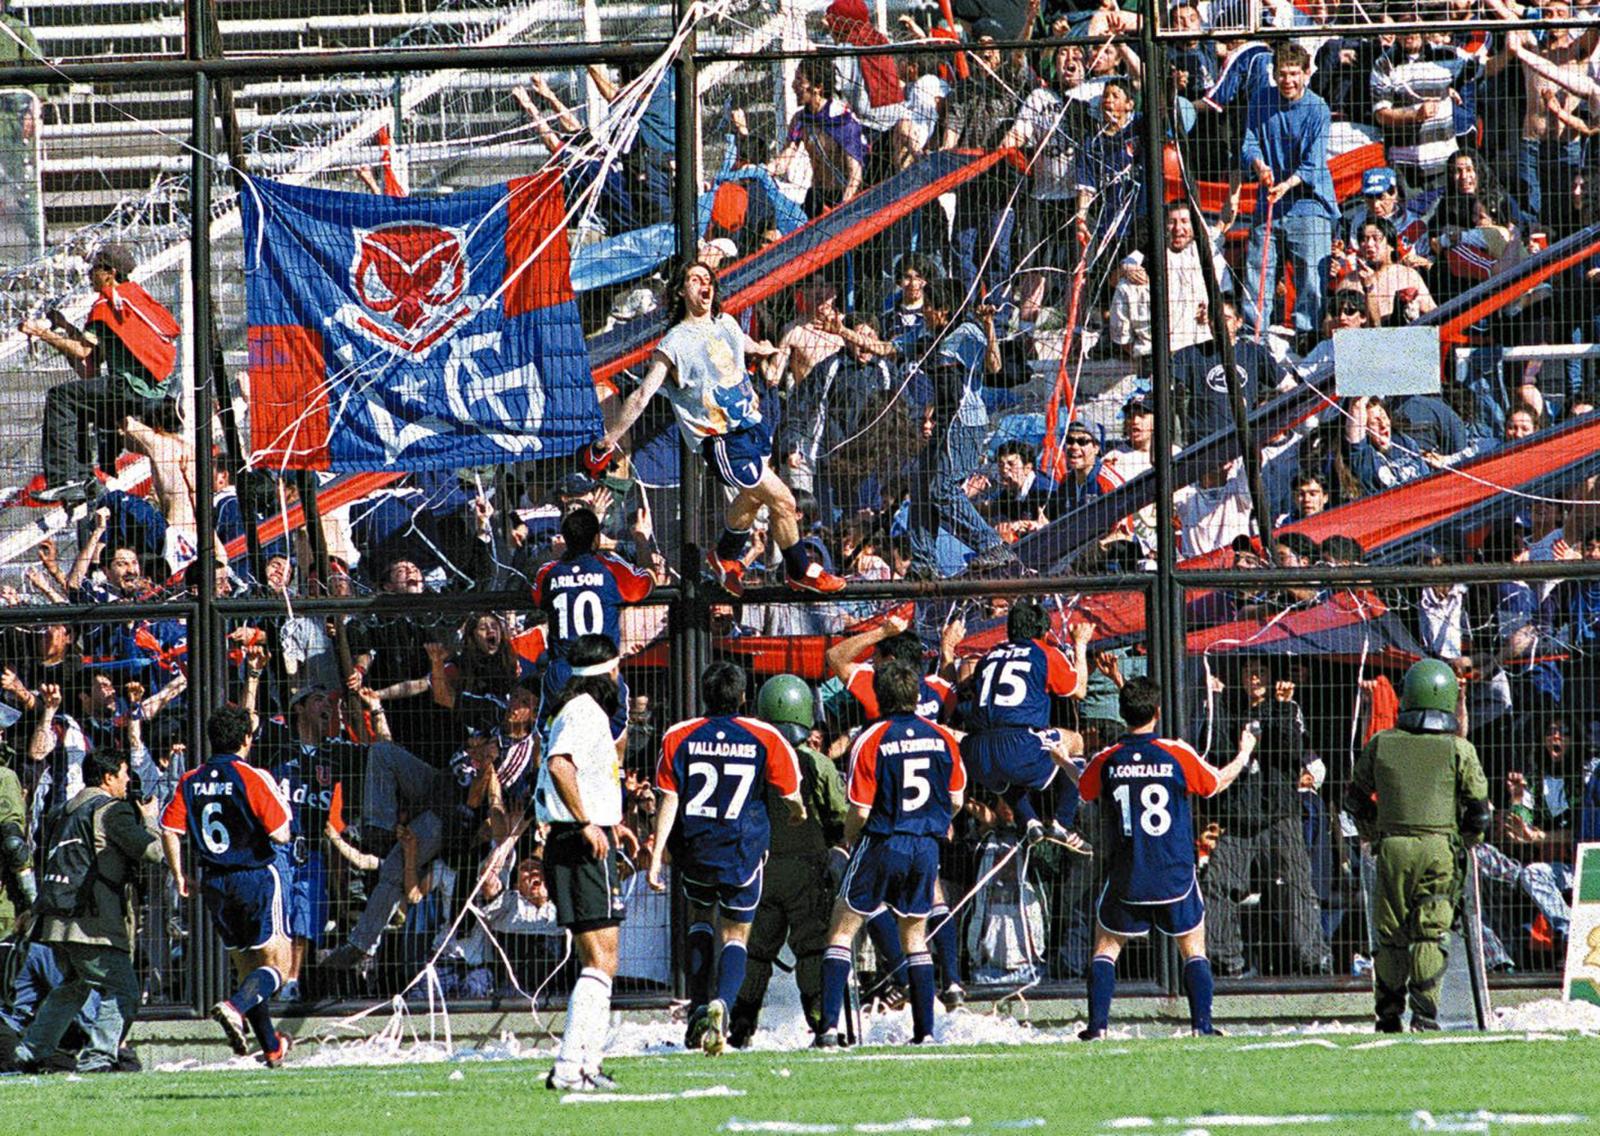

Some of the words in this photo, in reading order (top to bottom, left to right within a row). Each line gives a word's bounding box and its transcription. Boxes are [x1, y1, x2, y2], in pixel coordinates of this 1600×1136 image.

[550, 573, 604, 591] ARILSON
[552, 590, 604, 640] 10
[979, 661, 1032, 707] 15
[688, 741, 757, 759] VALLADARES
[685, 761, 756, 820] 27
[902, 758, 931, 812] 5
[1113, 783, 1172, 837] 18
[202, 802, 231, 854] 6
